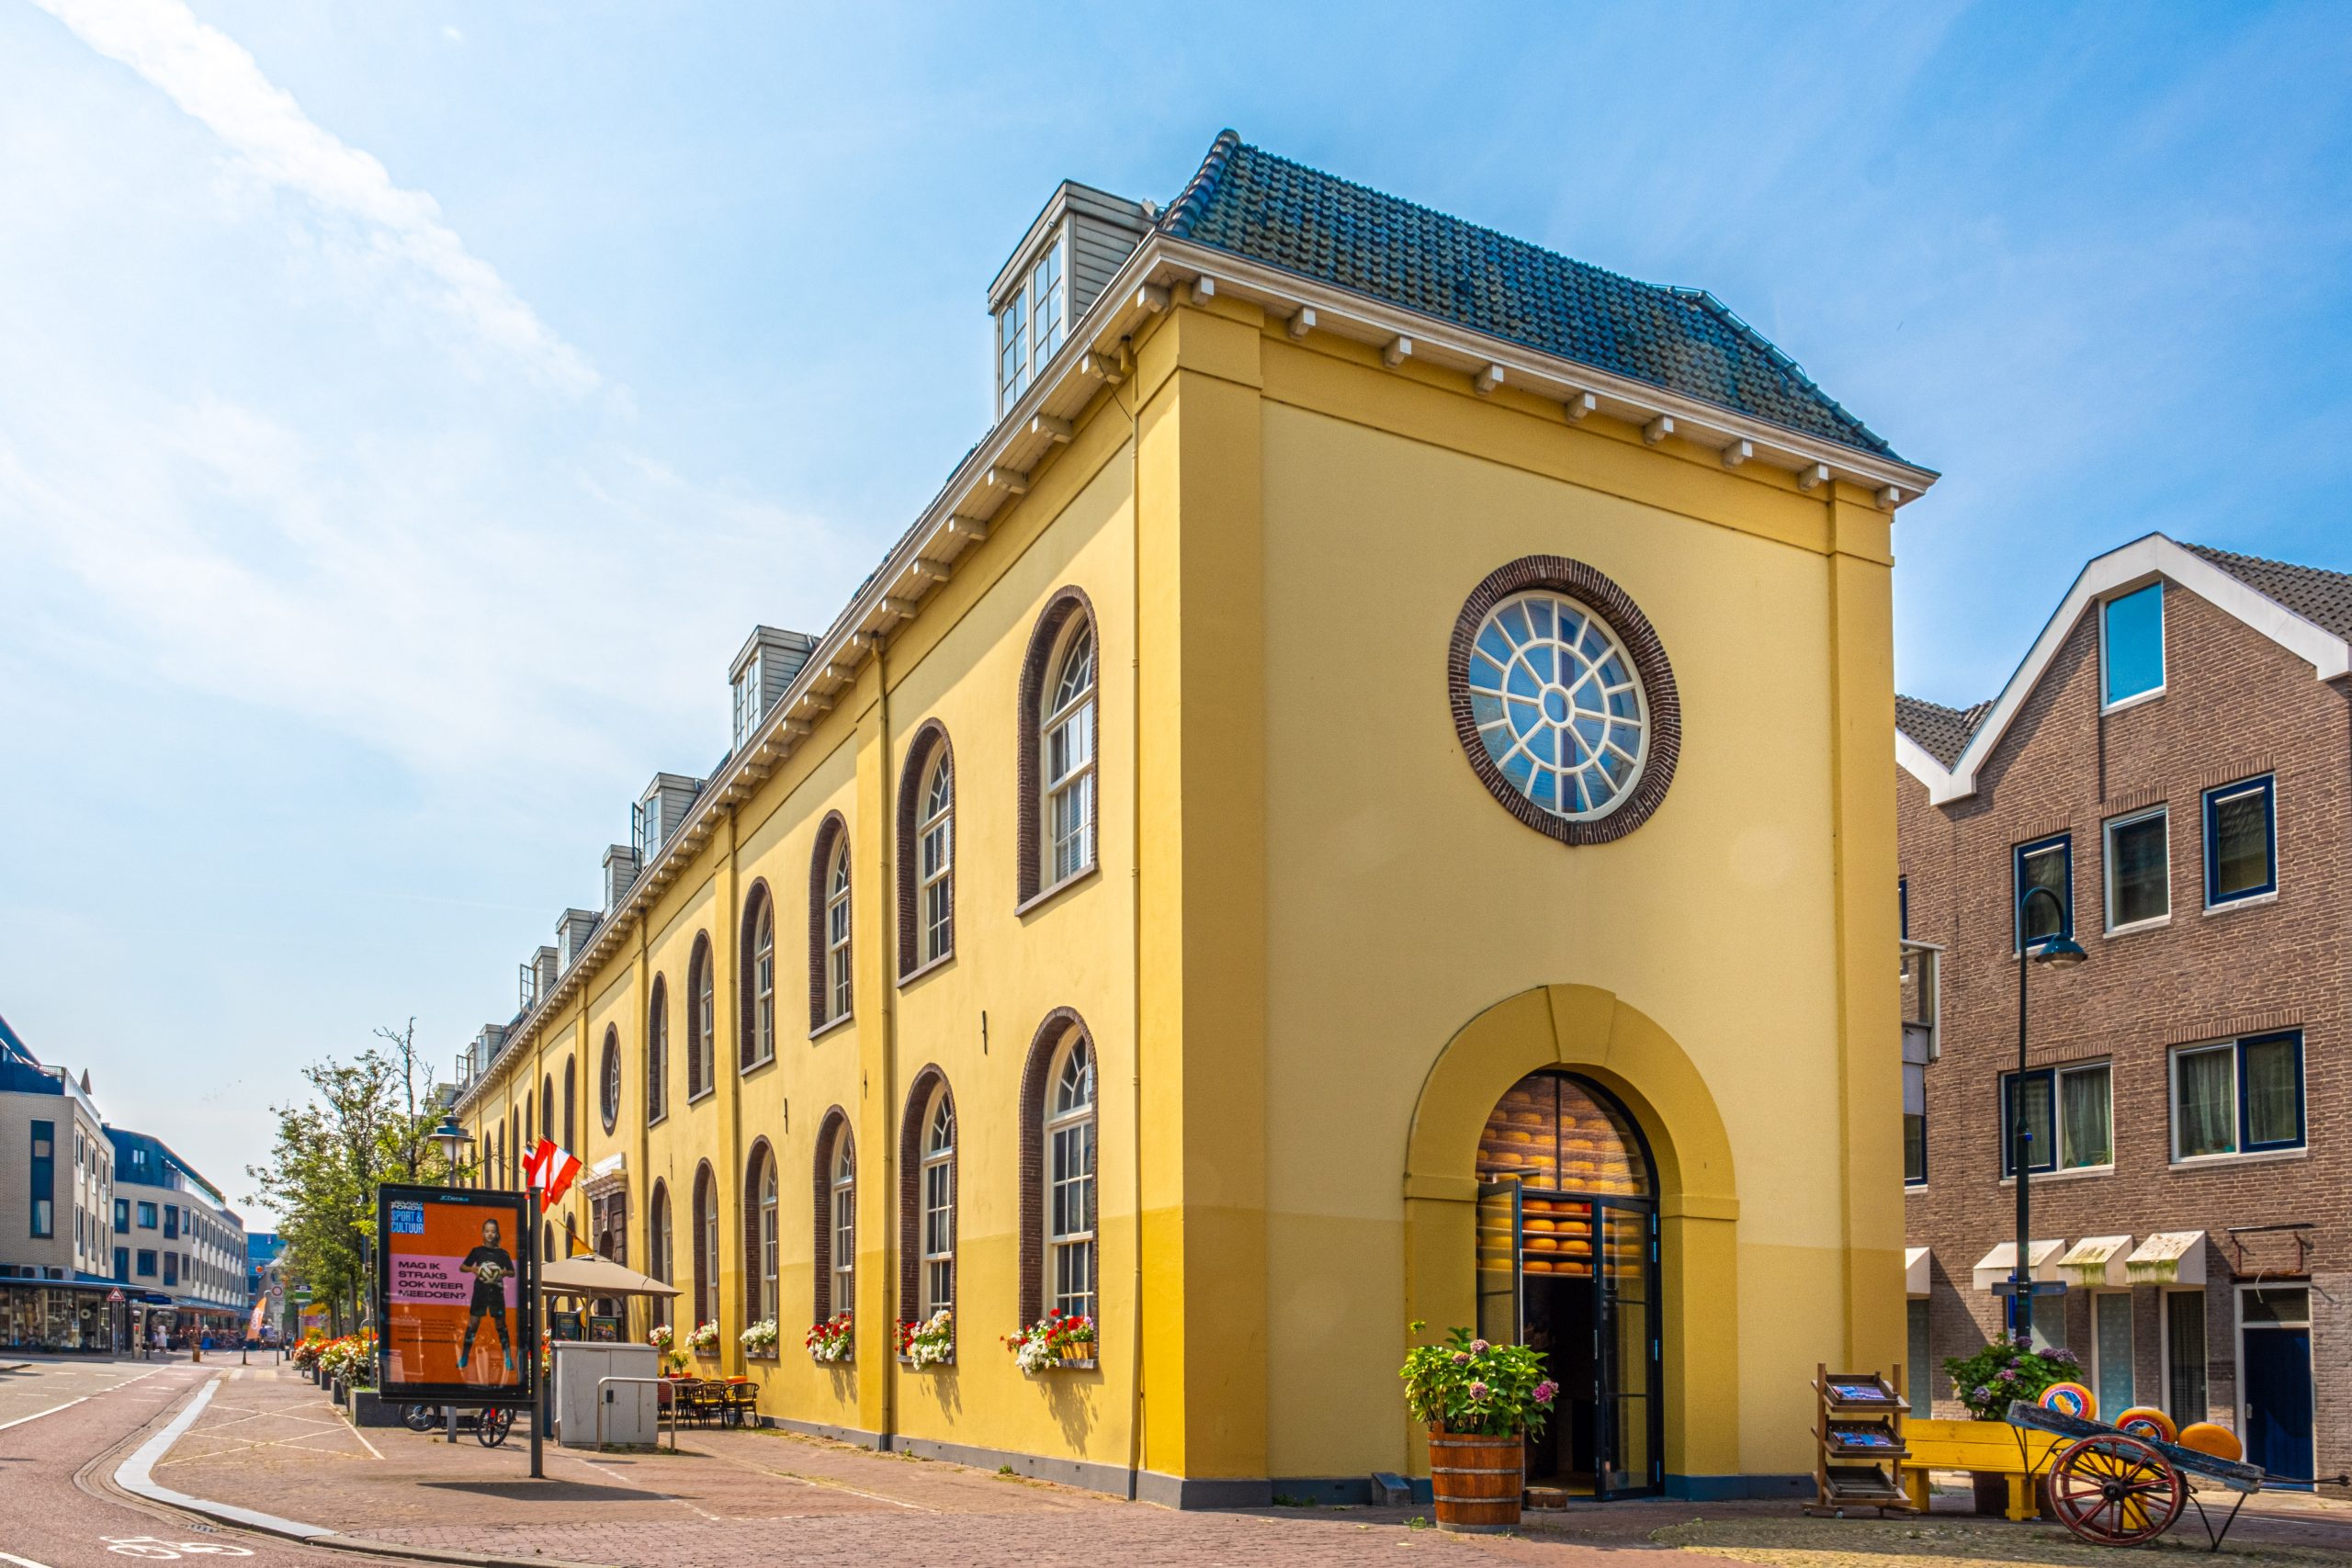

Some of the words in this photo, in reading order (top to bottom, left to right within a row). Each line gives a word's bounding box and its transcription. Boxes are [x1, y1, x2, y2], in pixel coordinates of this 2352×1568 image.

[391, 1210, 415, 1222] SPORT
[416, 1212, 423, 1223] &
[391, 1222, 424, 1234] CULTUUR
[398, 1270, 447, 1280] STRAKS
[398, 1290, 466, 1299] MEEDOEN?
